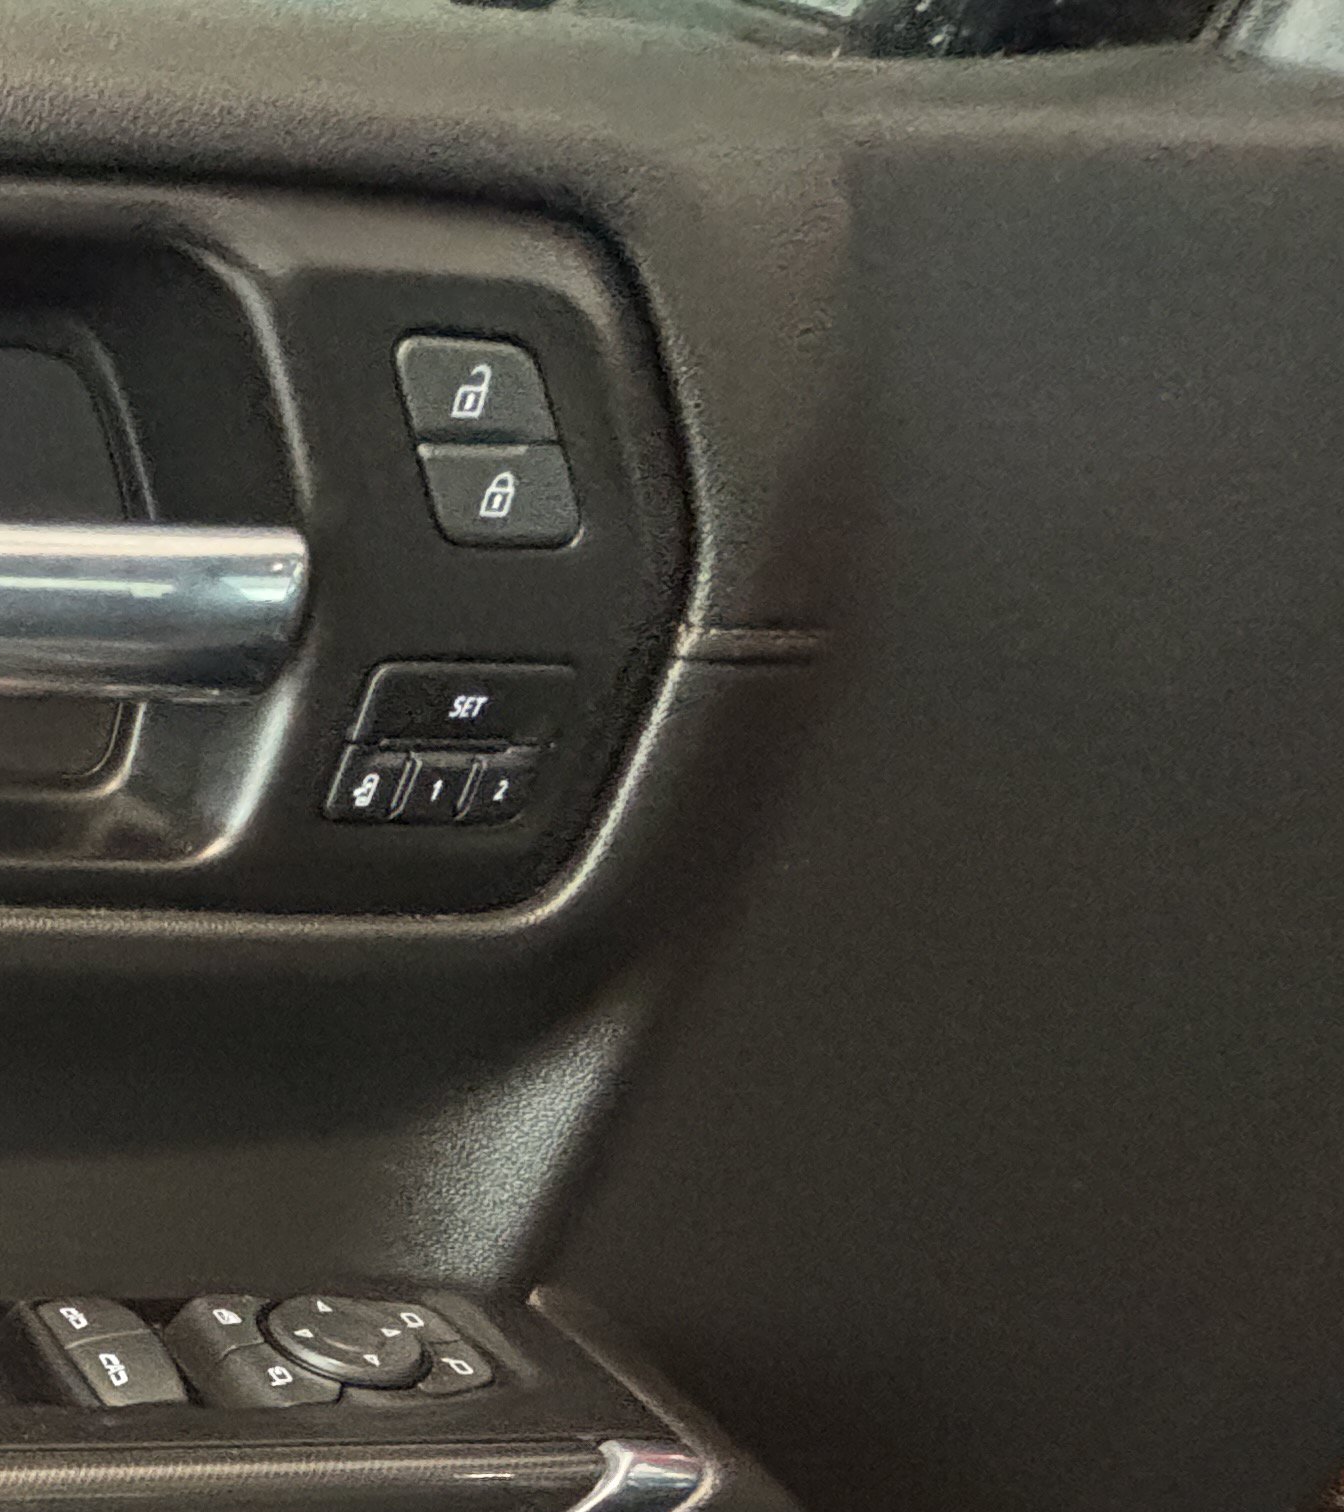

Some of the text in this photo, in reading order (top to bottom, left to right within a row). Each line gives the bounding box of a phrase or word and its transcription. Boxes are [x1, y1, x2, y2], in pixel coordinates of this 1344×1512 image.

[448, 696, 489, 718] SET
[430, 780, 443, 802] 1
[493, 780, 509, 801] 2
